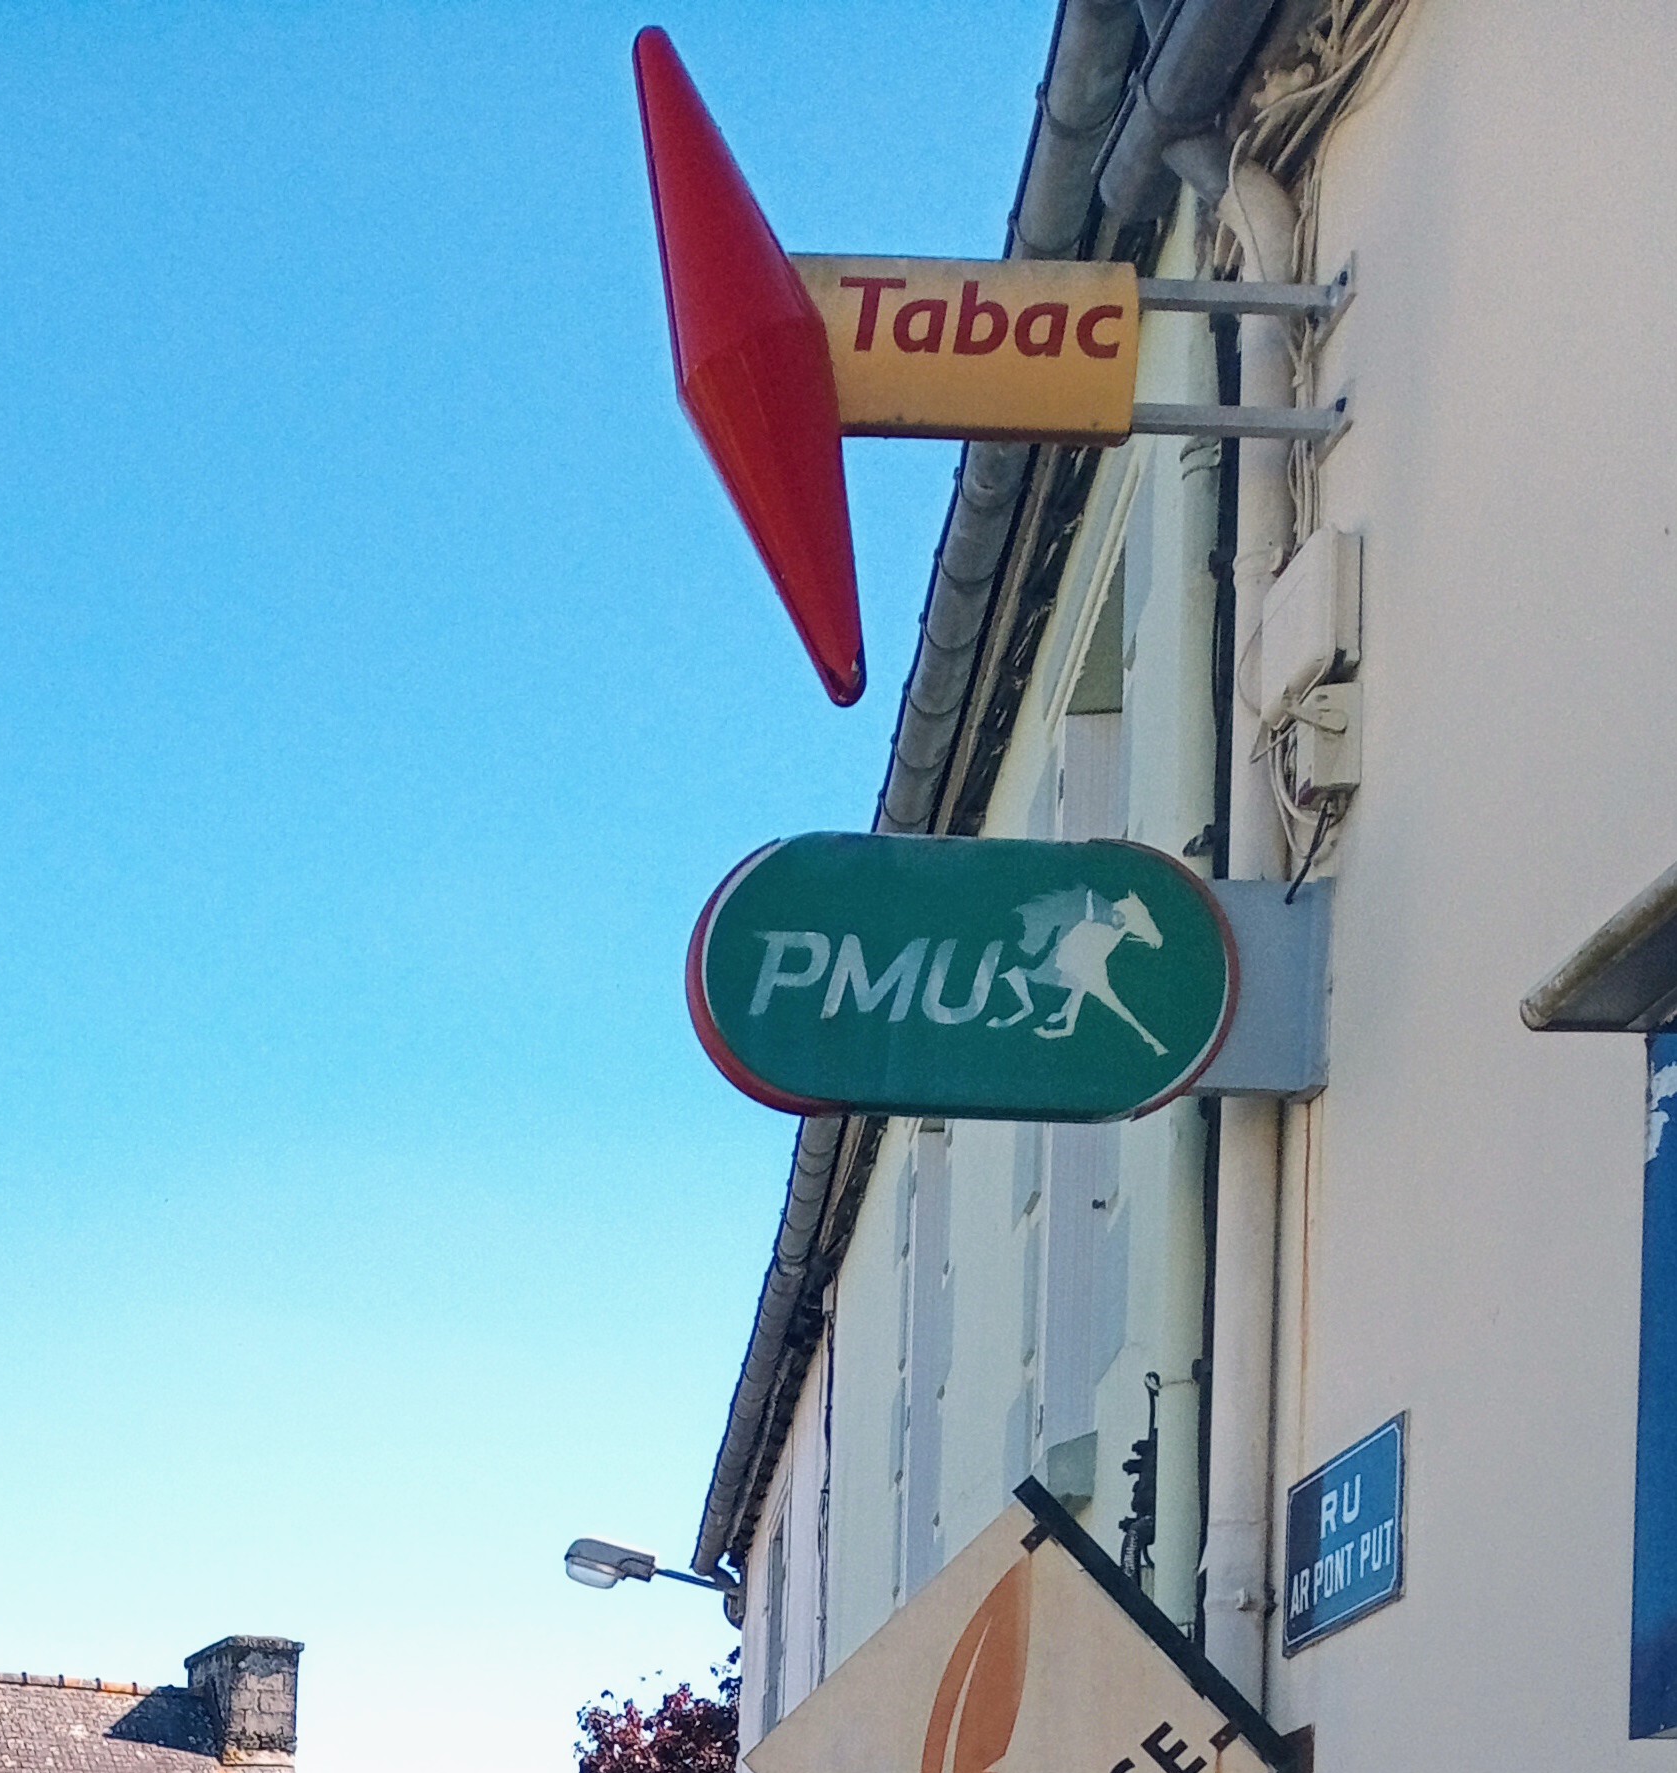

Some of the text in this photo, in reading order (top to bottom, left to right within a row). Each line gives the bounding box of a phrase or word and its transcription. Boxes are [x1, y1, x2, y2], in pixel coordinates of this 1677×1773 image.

[839, 274, 1123, 359] Tabac
[748, 929, 1005, 1025] PMU
[1320, 1474, 1361, 1539] RU
[1289, 1518, 1394, 1619] AR PONT PUT
